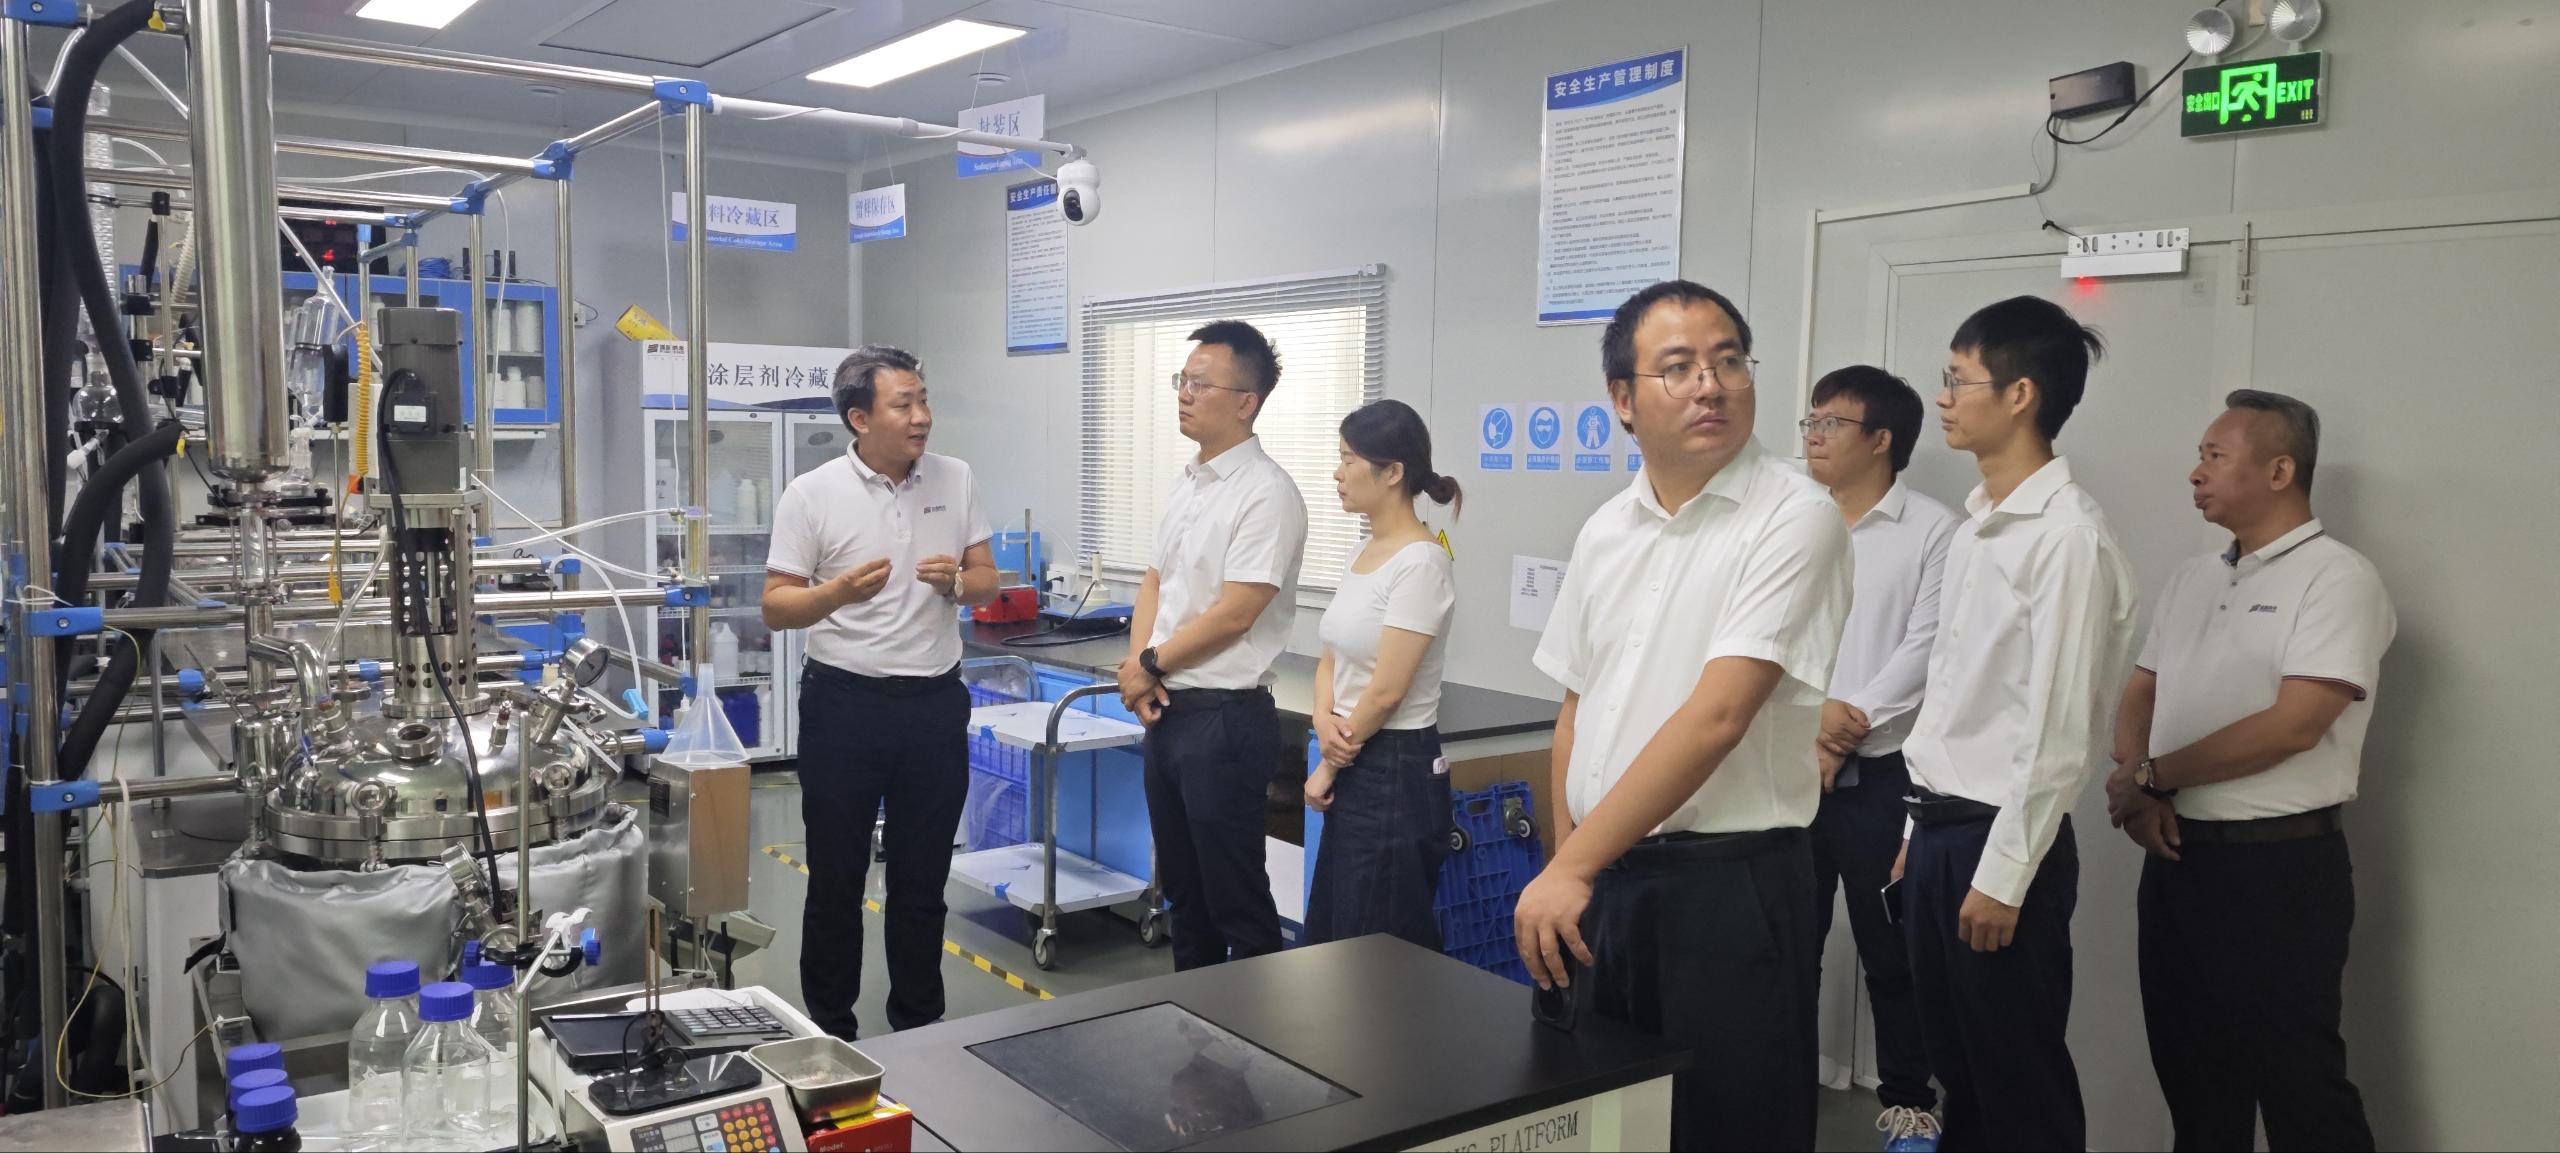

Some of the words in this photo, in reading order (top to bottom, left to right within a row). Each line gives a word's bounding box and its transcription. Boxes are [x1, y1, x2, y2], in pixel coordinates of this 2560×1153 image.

[1554, 59, 1675, 98] 安全生产管理制度
[2277, 79, 2314, 103] EXIT
[1010, 183, 1056, 203] 安全生产责任制
[708, 203, 780, 228] 料冷藏区
[708, 363, 838, 389] 涂层剂冷藏
[1489, 1111, 1579, 1153] PLATFORM
